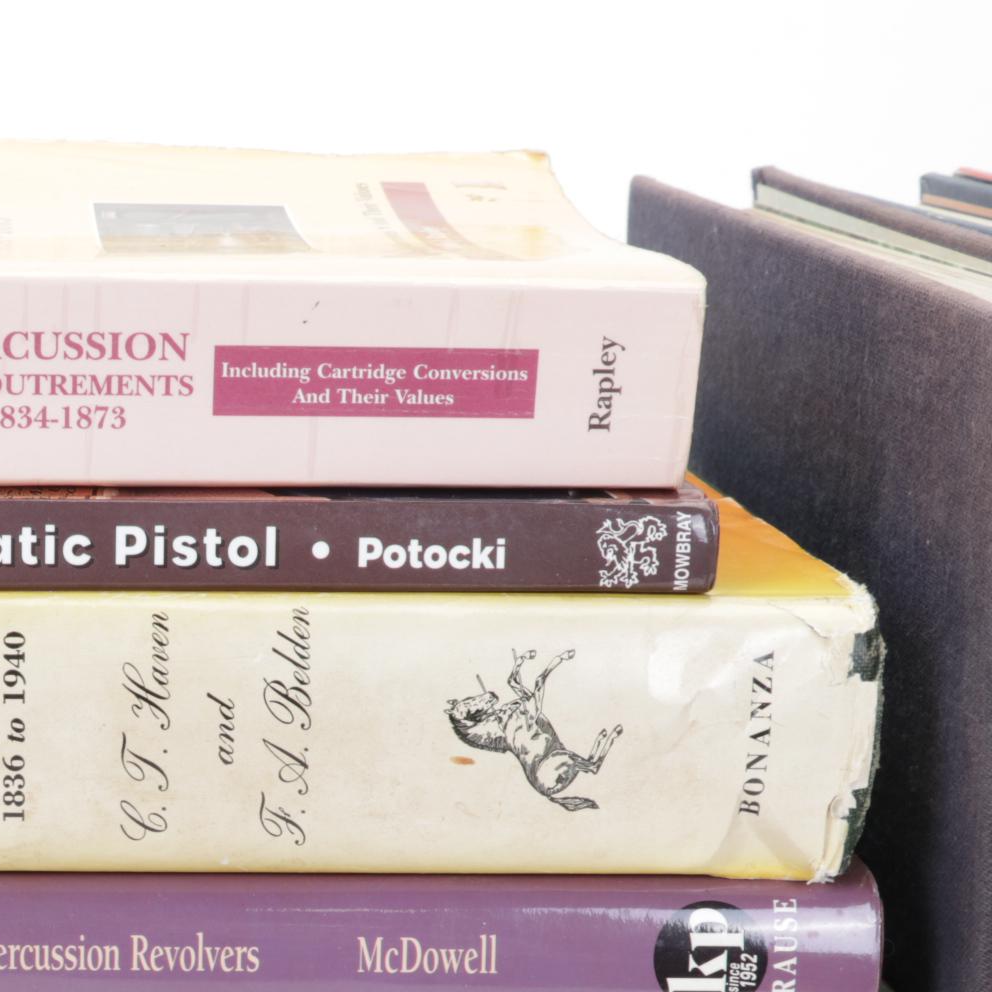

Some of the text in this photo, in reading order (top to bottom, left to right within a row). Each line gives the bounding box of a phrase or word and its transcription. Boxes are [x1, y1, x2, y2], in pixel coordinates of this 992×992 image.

[222, 362, 528, 384] Including Cartridge Conversions
[292, 388, 454, 405] And Their Values
[588, 336, 625, 431] Rapley
[115, 525, 276, 567] Pistol
[358, 537, 505, 569] Potocki
[672, 511, 692, 590] MOWBRAY
[2, 632, 25, 821] 1836 to 1940
[120, 611, 171, 841] C. T. Haven
[207, 693, 234, 765] and
[259, 607, 313, 847] F. A. Belden
[738, 648, 776, 817] BONANZA
[131, 932, 259, 972] Revolvers
[358, 934, 497, 974] McDowell
[740, 951, 759, 989] 1952
